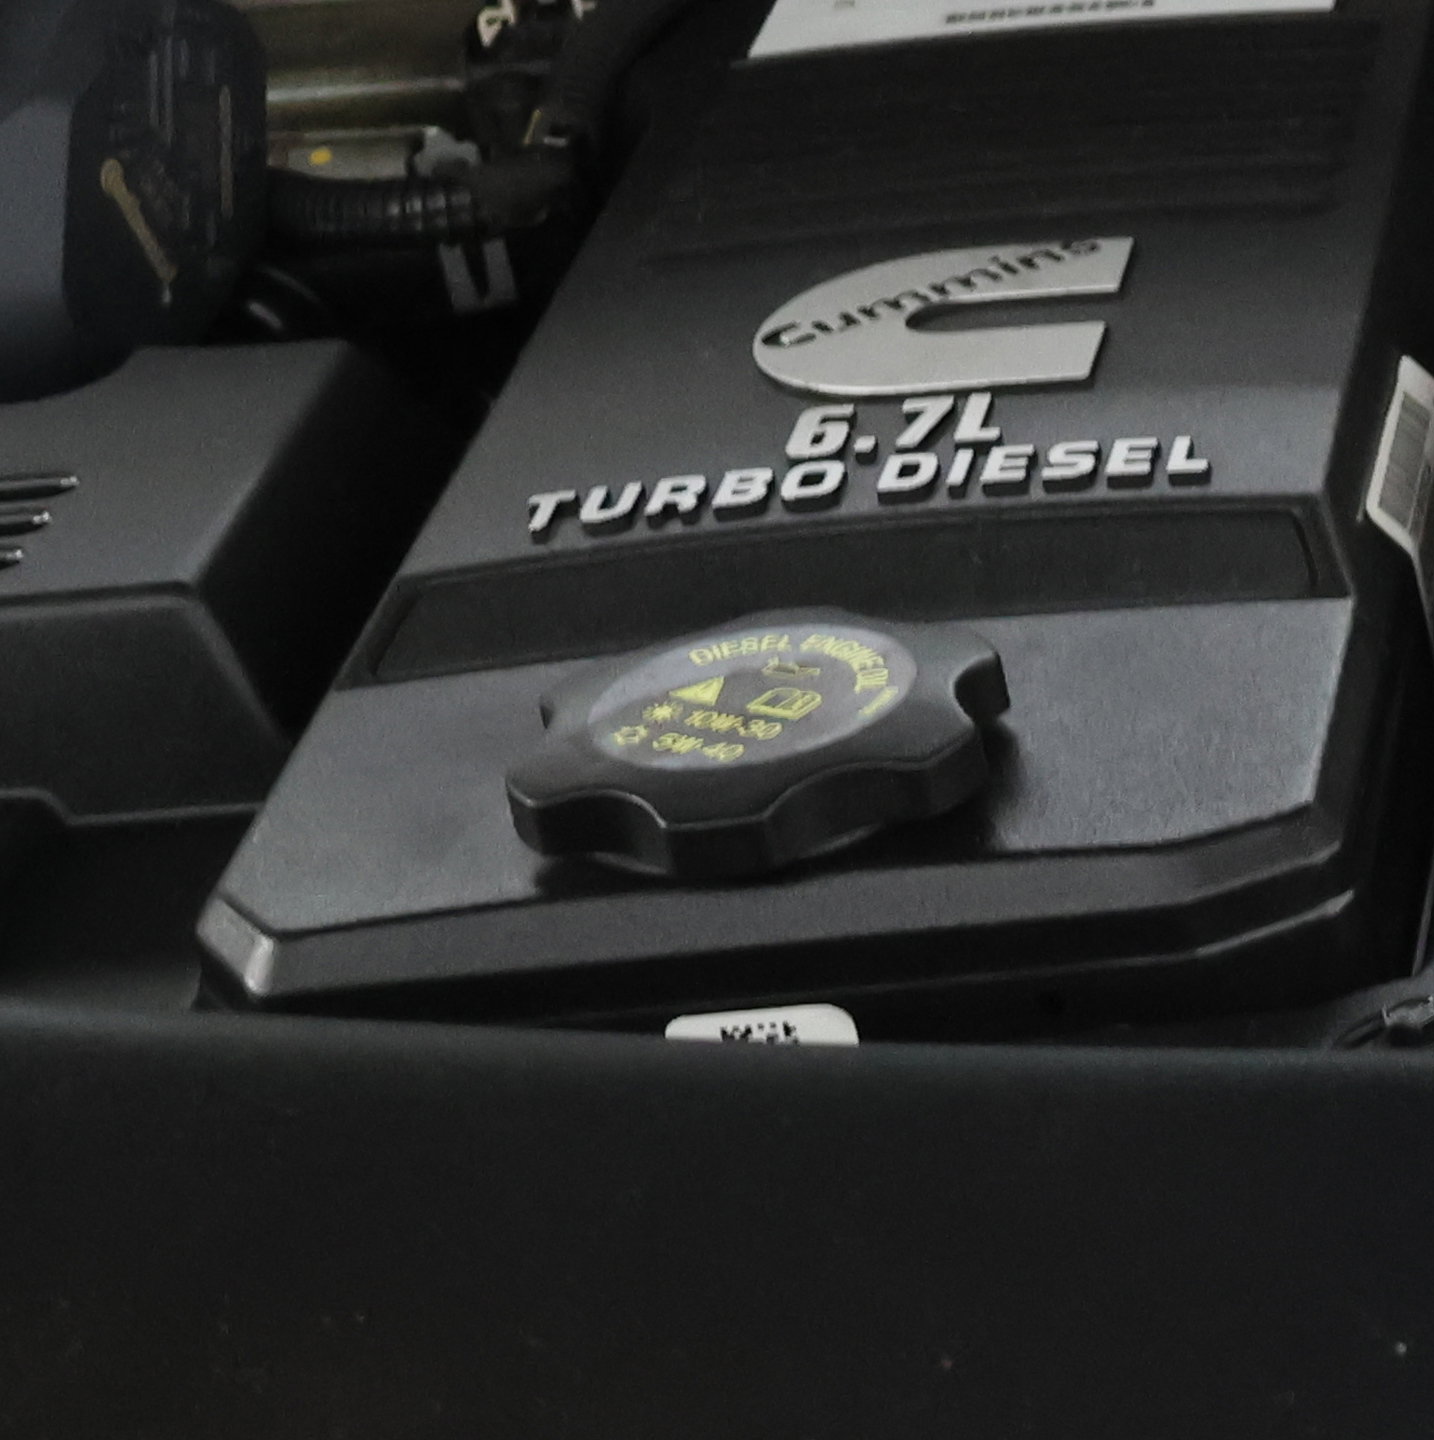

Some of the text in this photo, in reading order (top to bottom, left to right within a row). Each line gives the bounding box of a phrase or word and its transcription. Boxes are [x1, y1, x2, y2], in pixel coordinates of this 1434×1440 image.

[760, 237, 1103, 349] Cummins
[784, 391, 1004, 462] 6.7L
[526, 433, 1213, 536] TURBO DIESEL
[687, 633, 792, 667] DIESEL
